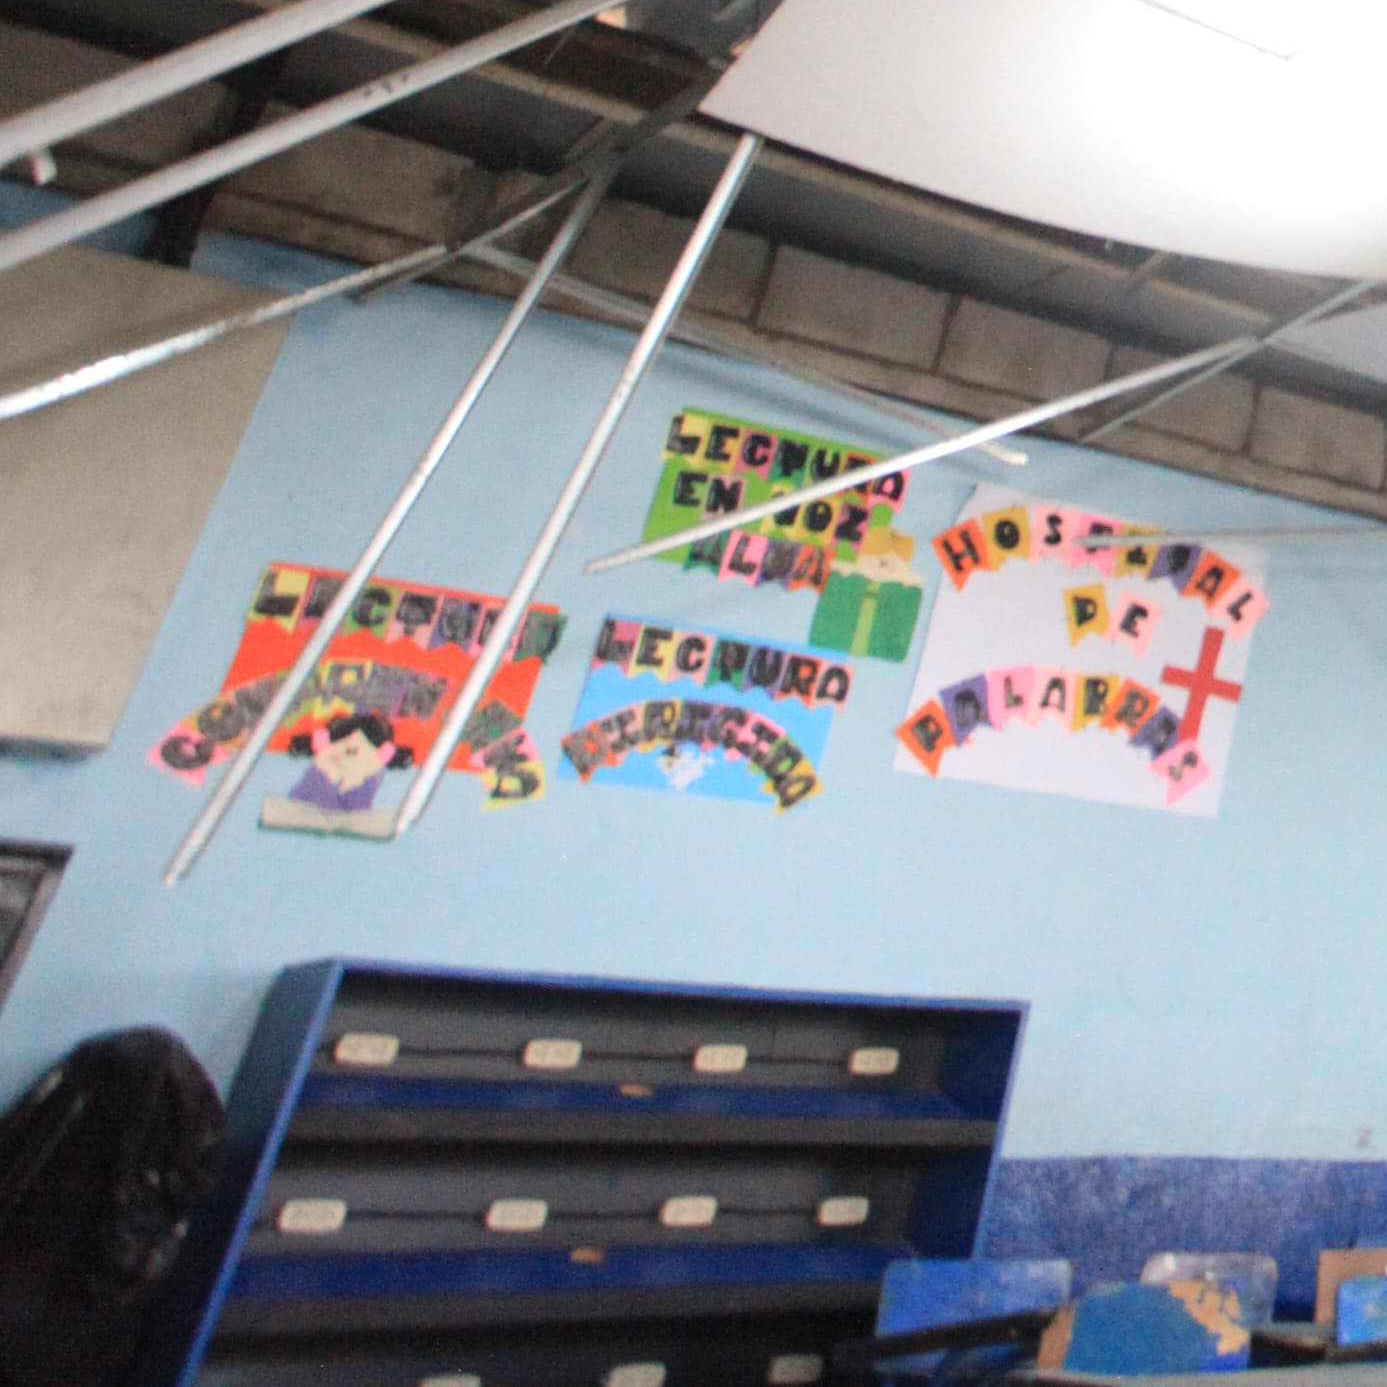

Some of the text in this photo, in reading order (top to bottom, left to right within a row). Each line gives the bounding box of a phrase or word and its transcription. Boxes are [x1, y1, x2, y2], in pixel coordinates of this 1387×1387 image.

[666, 415, 905, 501] LECTURA
[673, 471, 867, 542] EN VOZ
[942, 514, 1254, 622] HOSPITAL
[1072, 596, 1149, 637] DE
[597, 617, 851, 702] LECTURA
[910, 676, 1199, 782] PALABRAS
